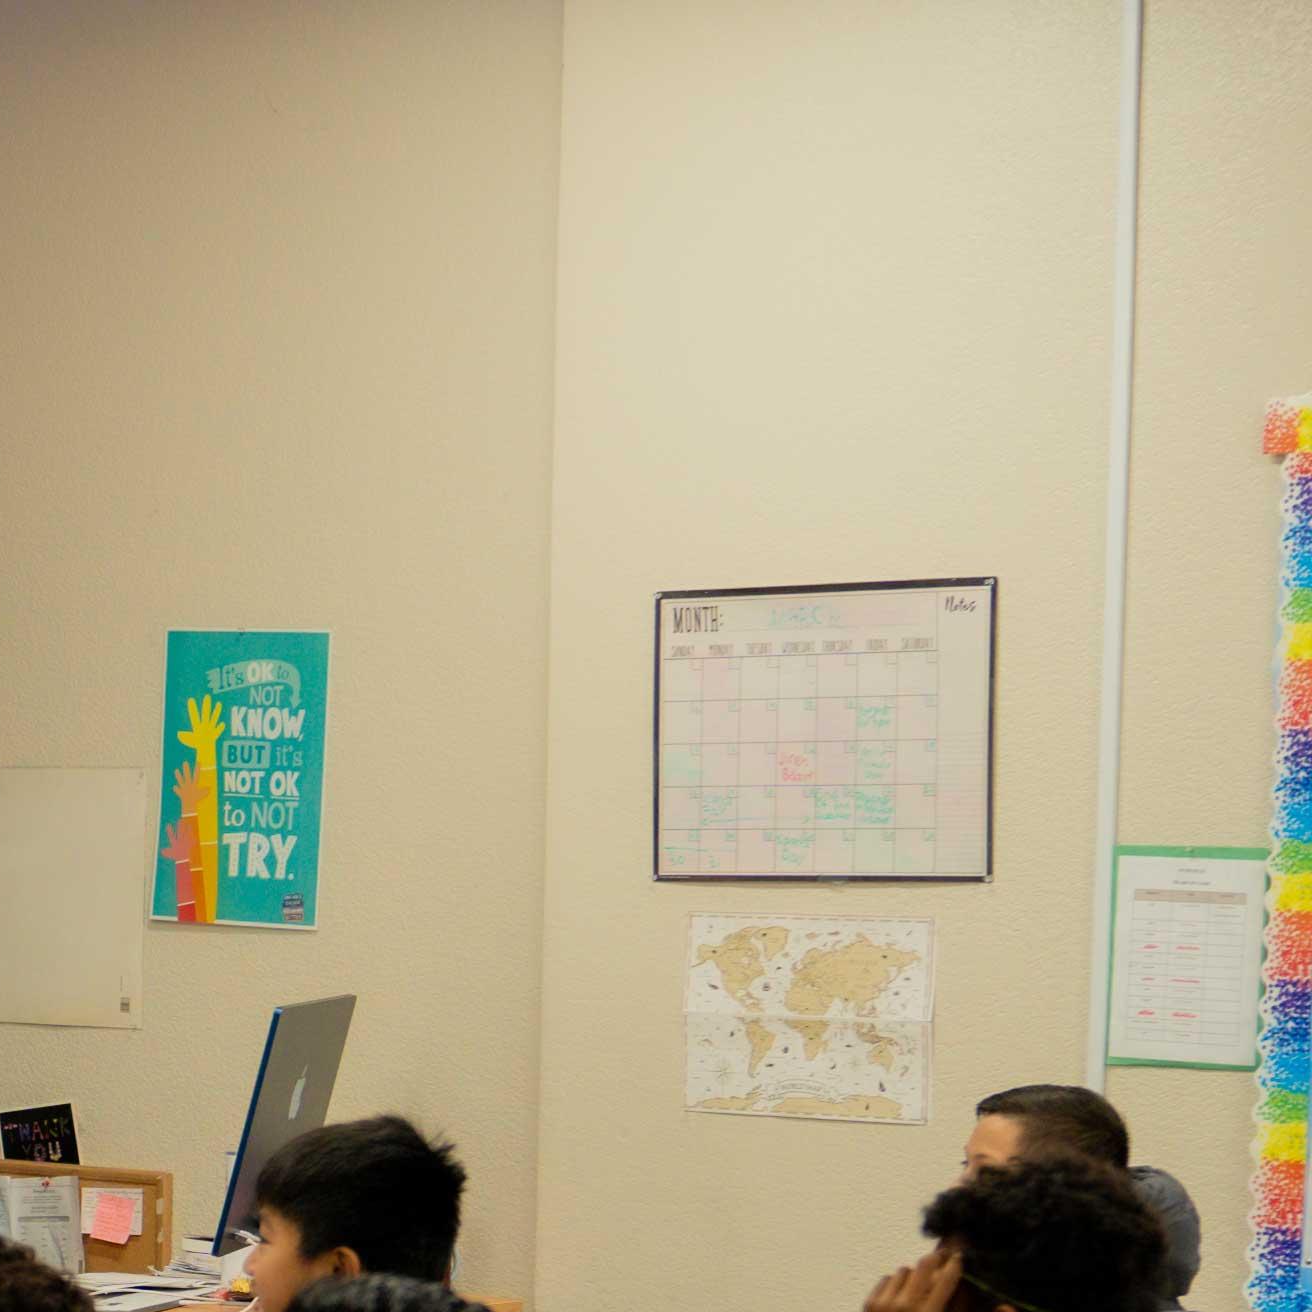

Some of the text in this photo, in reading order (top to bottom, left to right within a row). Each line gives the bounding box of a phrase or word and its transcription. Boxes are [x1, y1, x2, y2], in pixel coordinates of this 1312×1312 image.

[944, 595, 977, 614] Notes
[672, 606, 725, 634] MONTH:
[247, 661, 274, 684] OK
[249, 685, 285, 707] NOT
[230, 705, 307, 742] KNOW,
[227, 744, 304, 767] BUT it's
[223, 771, 299, 797] NOT OK
[223, 801, 299, 831] to NOT
[222, 831, 299, 881] TRY.
